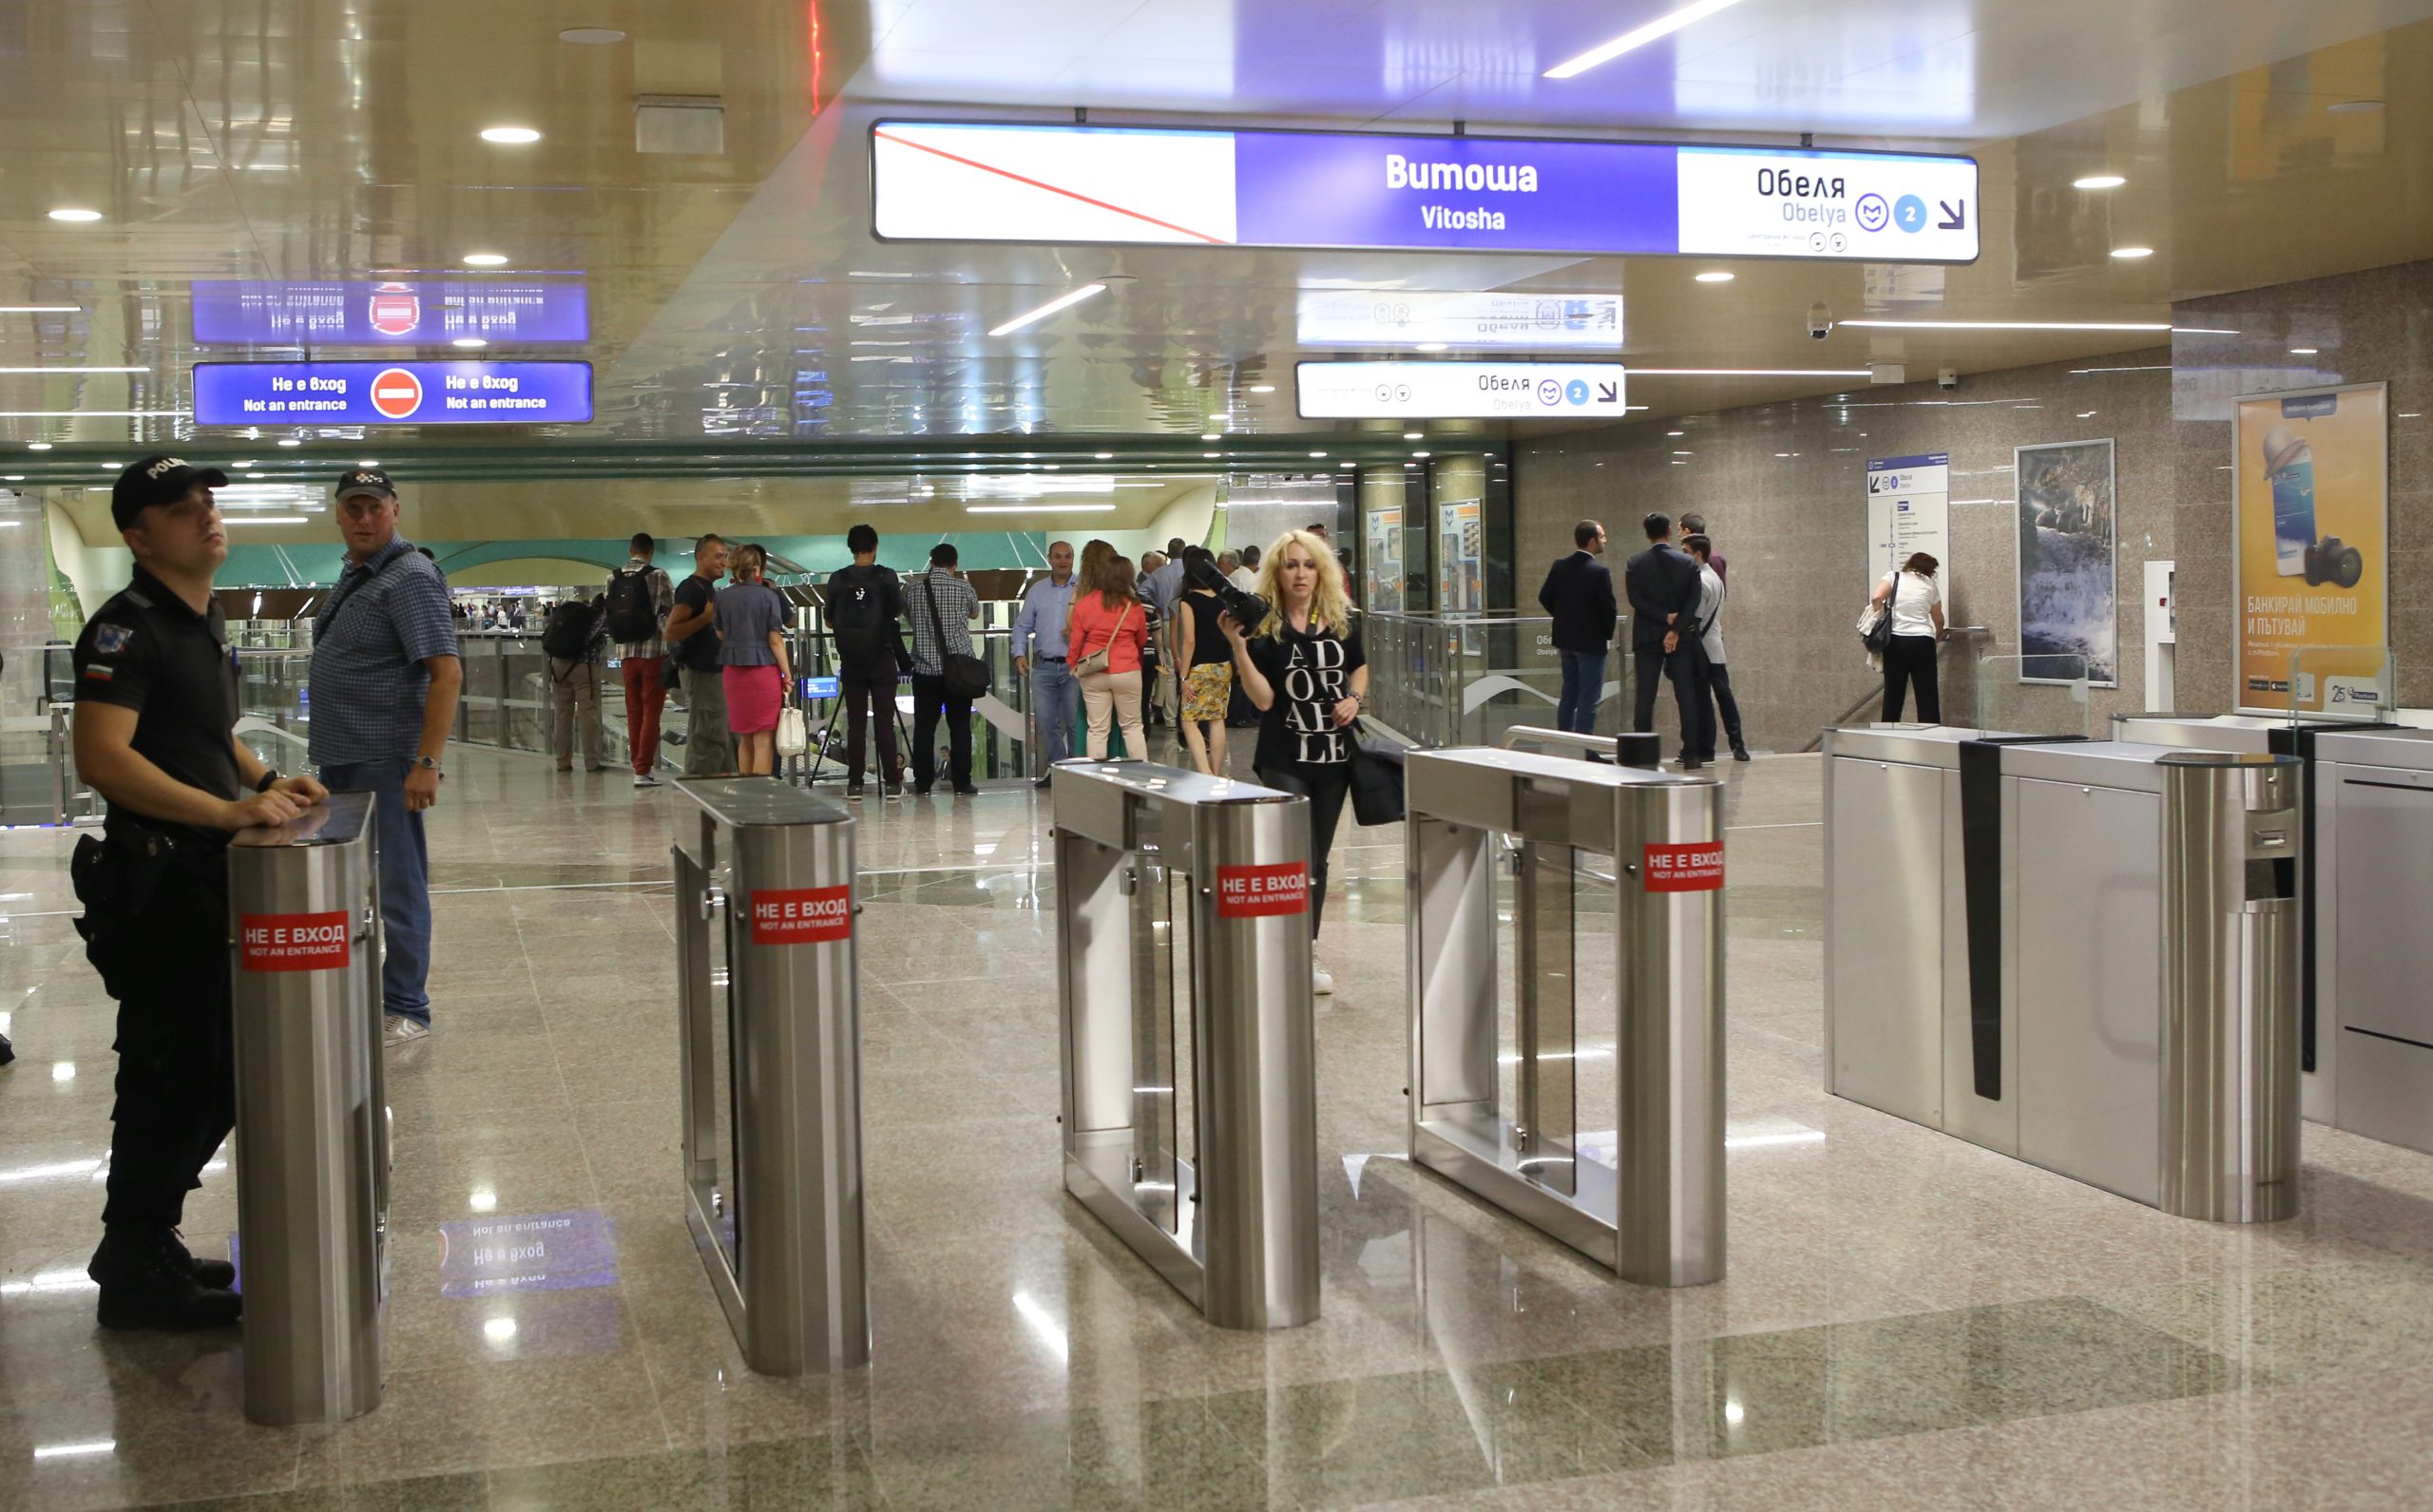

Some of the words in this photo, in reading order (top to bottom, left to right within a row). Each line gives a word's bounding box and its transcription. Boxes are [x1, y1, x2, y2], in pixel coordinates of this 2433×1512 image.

[1387, 154, 1538, 192] Витоша
[1757, 168, 1846, 199] Обеля
[1421, 205, 1505, 230] Vitosha
[1783, 202, 1846, 227] Obelya
[272, 376, 293, 392] Не
[297, 379, 306, 391] е
[310, 376, 347, 394] вход
[446, 375, 466, 390] Не
[469, 377, 479, 389] е
[482, 375, 519, 392] вход
[1479, 374, 1530, 391] Обеля
[243, 399, 266, 411] Not
[268, 401, 285, 411] an
[288, 399, 347, 411] entrance
[446, 396, 468, 409] Not
[470, 398, 487, 409] an
[489, 397, 546, 409] entrance
[1493, 398, 1531, 411] Obelya
[2248, 594, 2302, 614] БАНКИРАЙ
[2305, 597, 2357, 615] МОБИЛНО
[2248, 618, 2255, 635] И
[2257, 616, 2306, 636] ПЪТУВАЙ
[1649, 854, 1673, 868] НЕ
[1676, 853, 1688, 868] Е
[1222, 878, 1246, 892] НЕ
[1251, 877, 1262, 892] Е
[1267, 872, 1306, 891] ВХОД
[756, 903, 779, 918] НЕ
[784, 903, 797, 918] Е
[802, 898, 848, 917] ВХОД
[1226, 895, 1245, 904] NOT
[1247, 894, 1261, 904] AN
[245, 928, 269, 944] НЕ
[275, 928, 287, 944] Е
[293, 925, 345, 943] ВХОД
[759, 922, 778, 930] NOT
[780, 921, 796, 929] AN
[249, 947, 268, 956] NOT
[270, 947, 285, 956] AN
